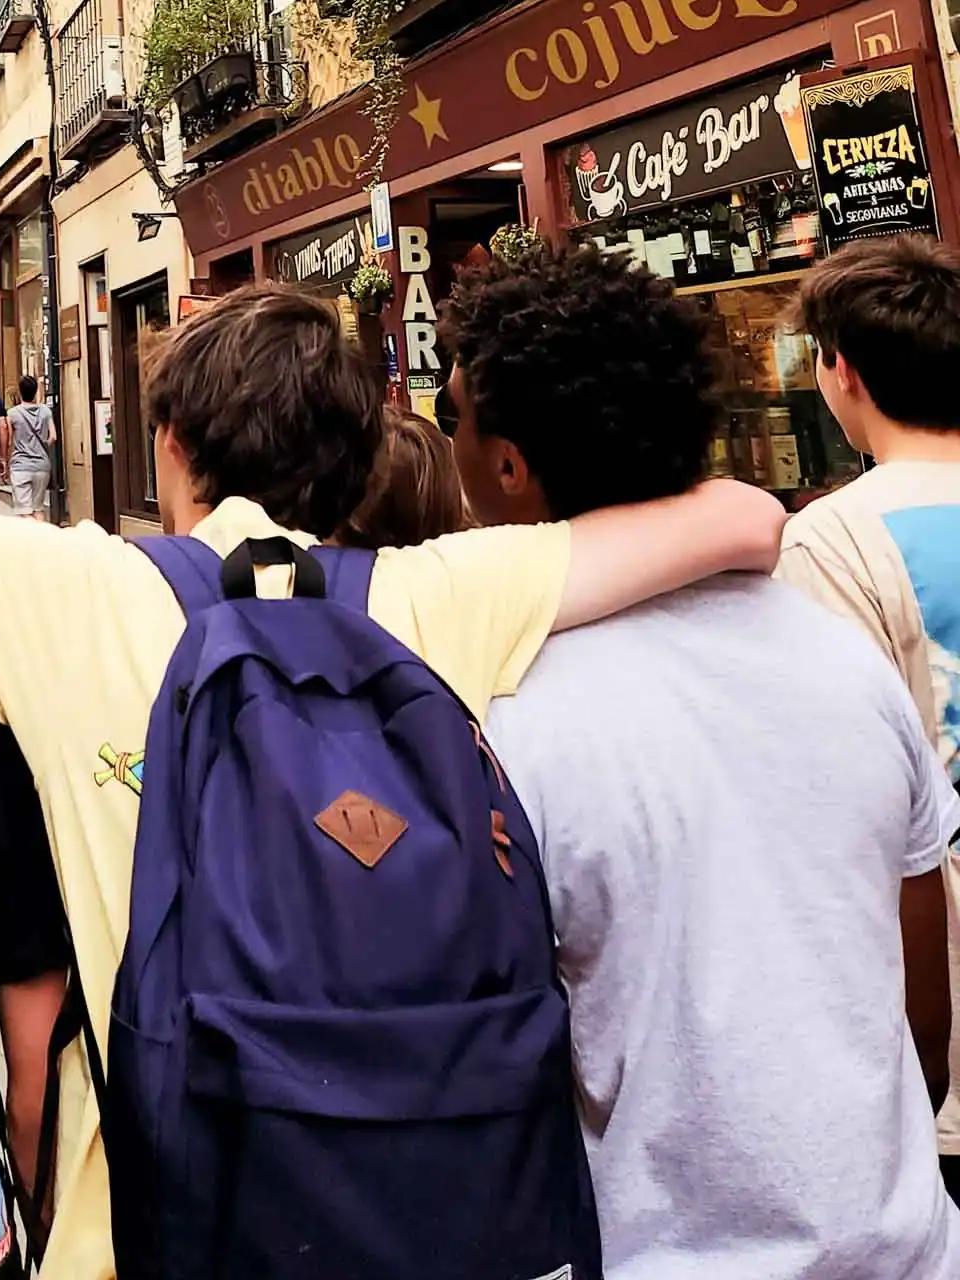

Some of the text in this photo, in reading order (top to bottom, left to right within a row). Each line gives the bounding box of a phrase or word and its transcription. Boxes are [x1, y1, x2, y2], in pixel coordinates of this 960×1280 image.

[627, 94, 770, 201] Café Bar
[823, 124, 916, 175] CERVEZA
[243, 134, 364, 216] diablo
[843, 177, 906, 199] ARTESANAS
[846, 203, 908, 224] SEGOVIANAS
[294, 238, 322, 282] VINOS
[324, 229, 356, 280] TAPAS
[398, 225, 441, 370] BAR
